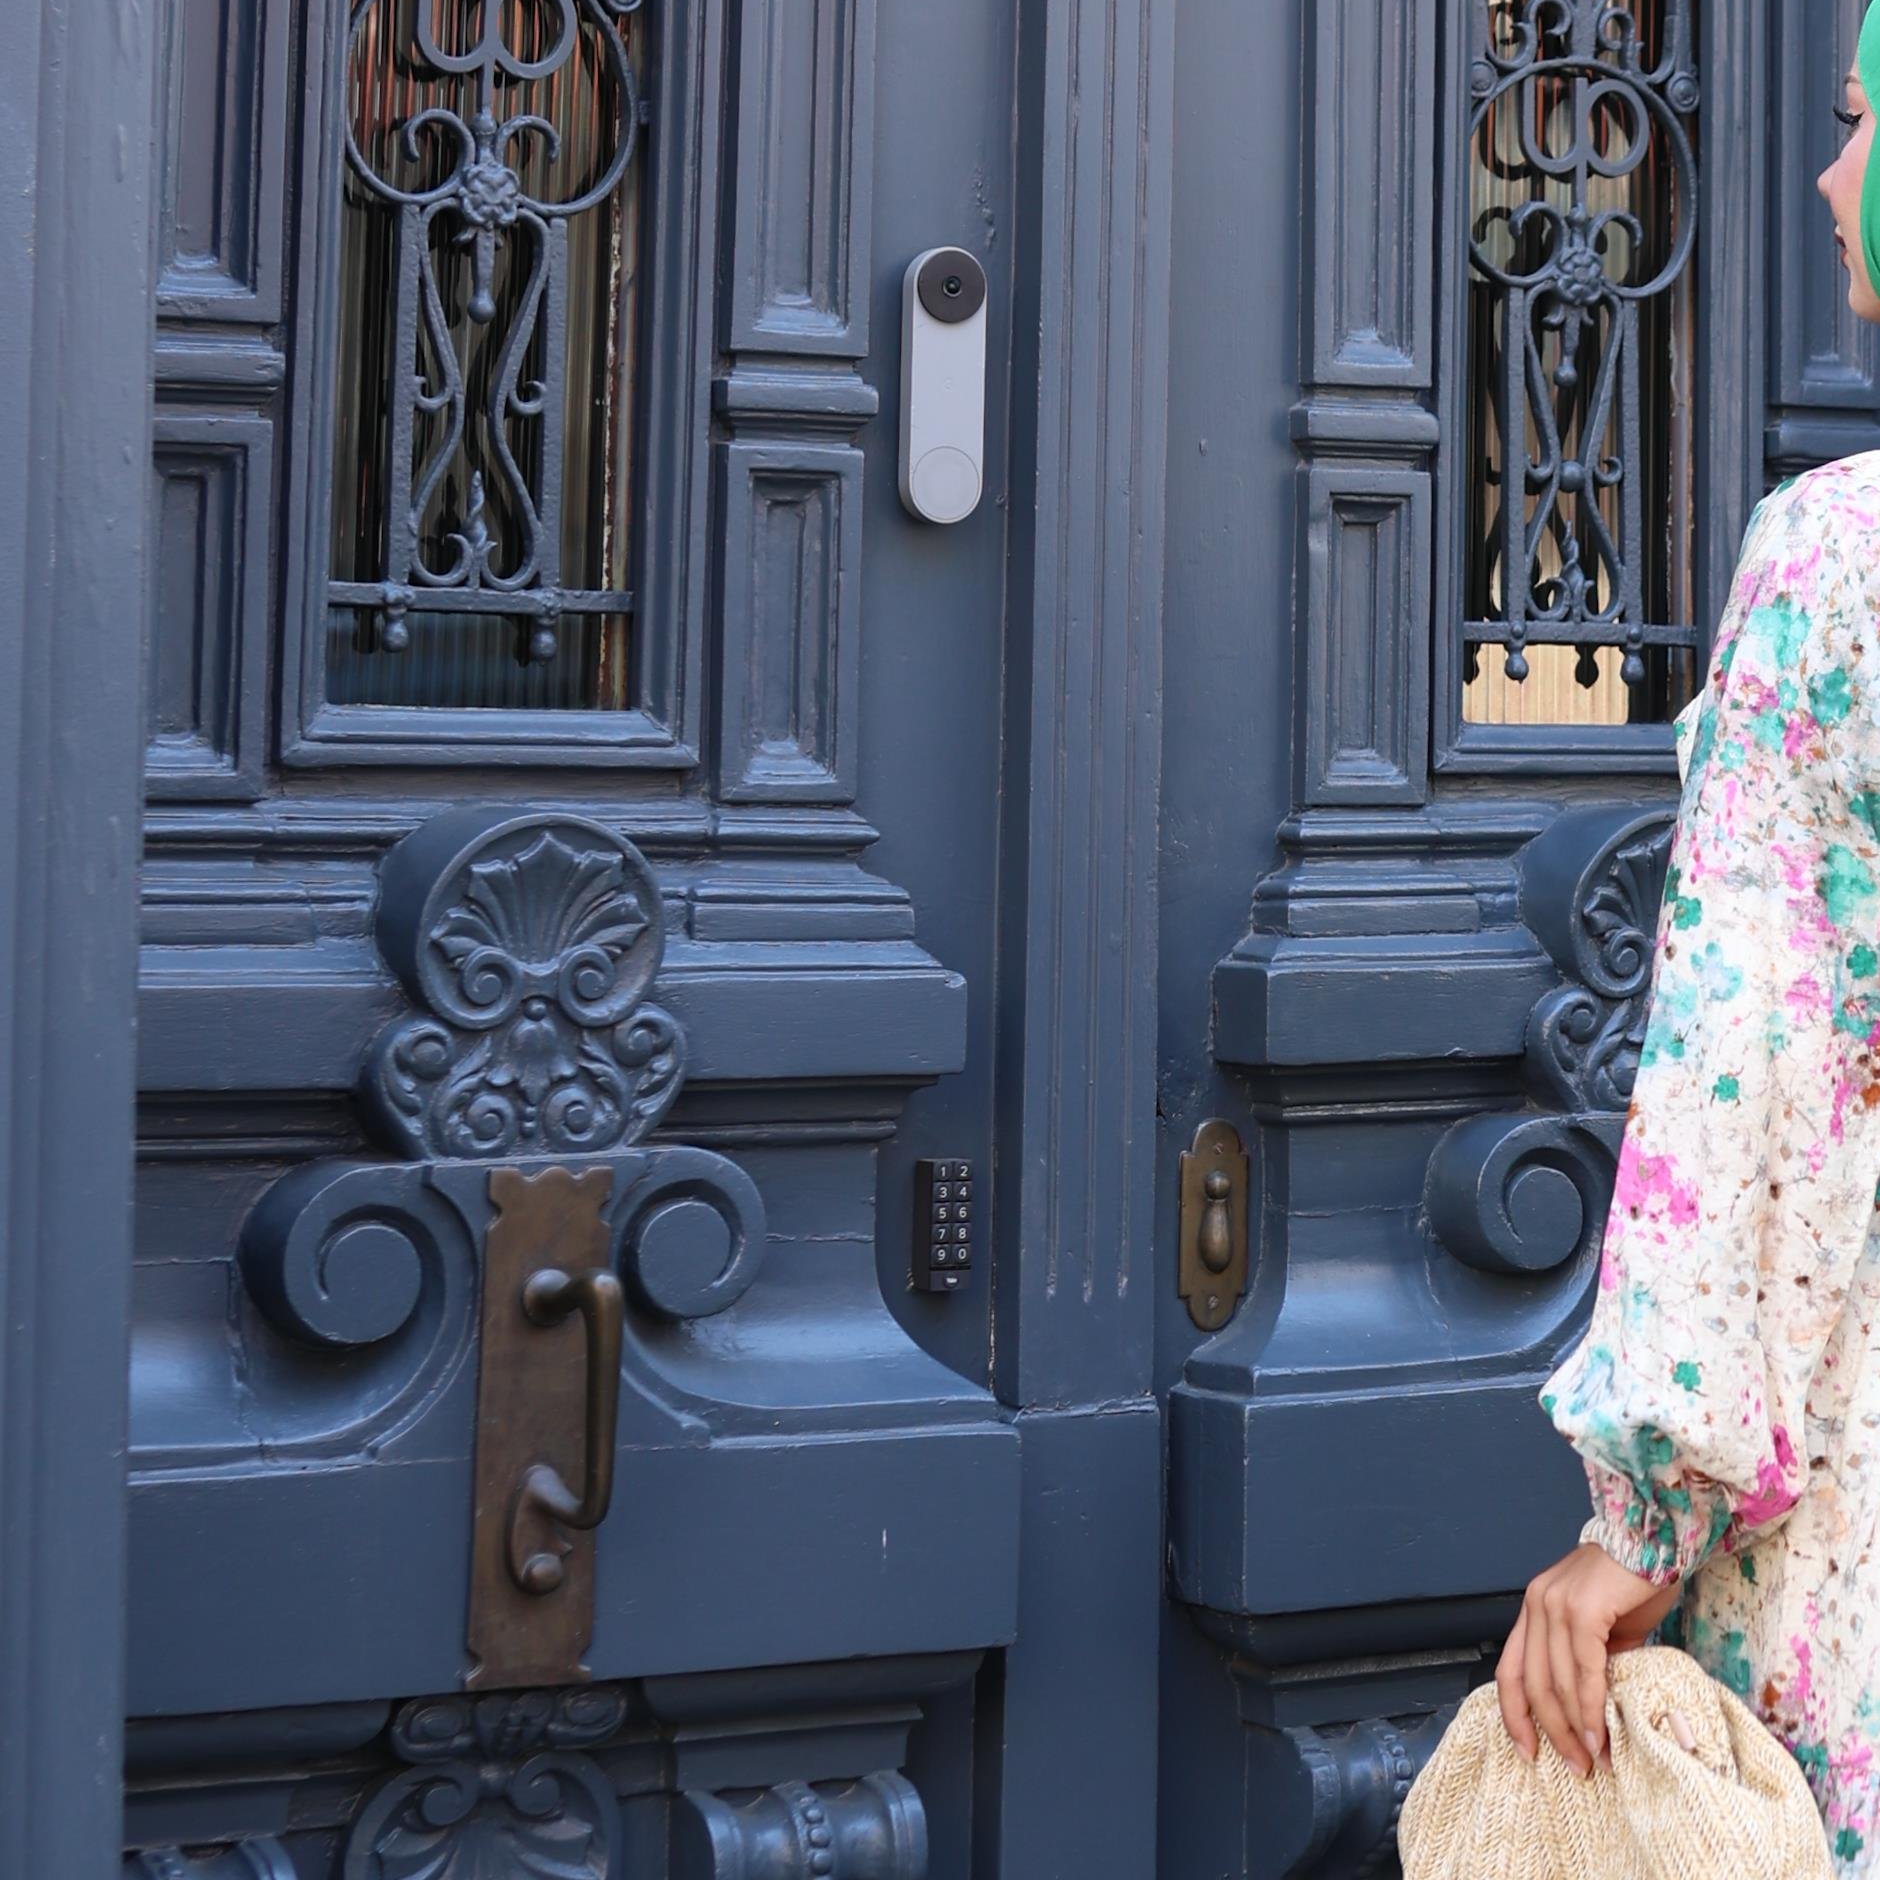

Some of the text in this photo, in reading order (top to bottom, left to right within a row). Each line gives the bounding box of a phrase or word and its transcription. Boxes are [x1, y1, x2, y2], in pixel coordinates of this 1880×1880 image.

[940, 1165, 969, 1177] 1 2
[939, 1186, 967, 1198] 3 4
[938, 1206, 967, 1219] 5 6
[938, 1227, 967, 1240] 7 8
[937, 1248, 967, 1261] 9 0
